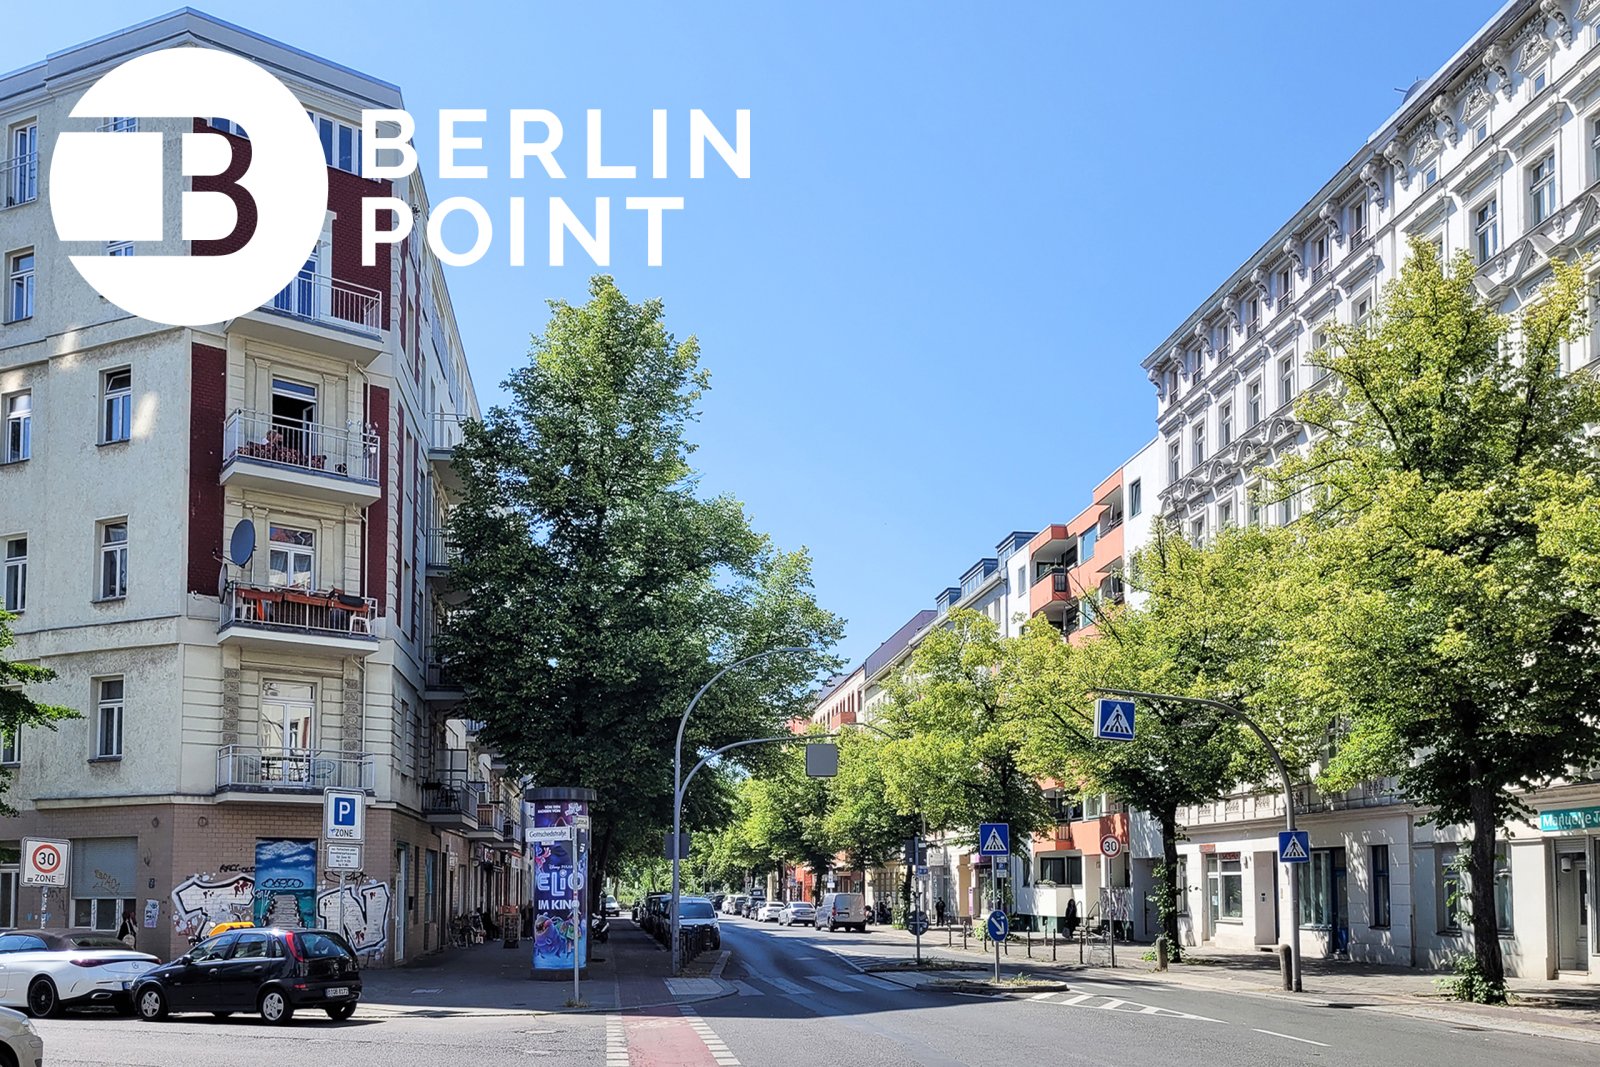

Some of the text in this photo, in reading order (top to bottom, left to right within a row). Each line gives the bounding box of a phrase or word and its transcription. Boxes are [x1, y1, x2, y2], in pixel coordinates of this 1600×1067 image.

[338, 801, 351, 822] P
[335, 828, 353, 838] ZONE
[1104, 841, 1117, 852] 30
[38, 852, 55, 866] 30
[34, 874, 56, 883] ZONE
[538, 900, 549, 910] IM
